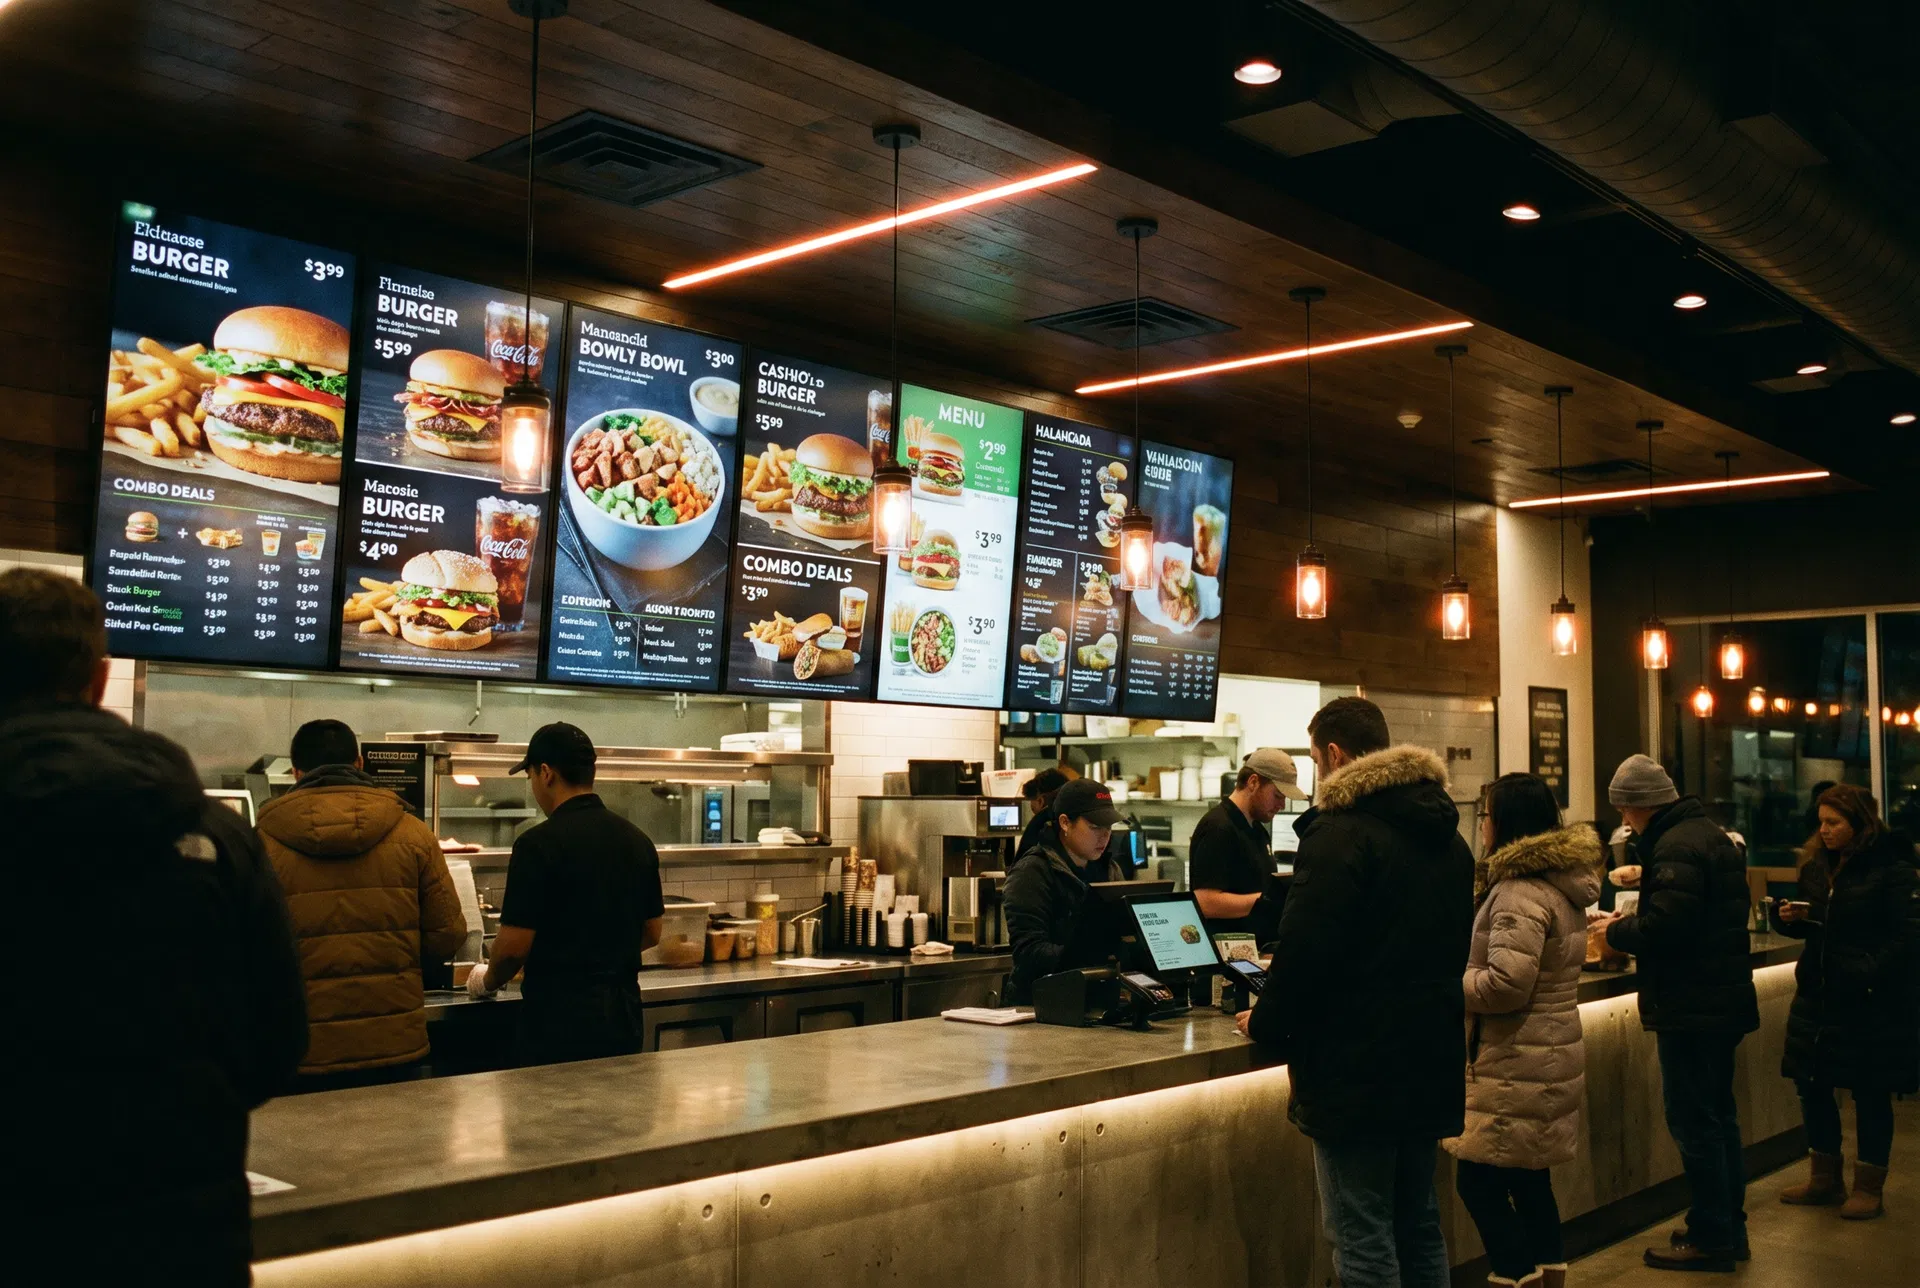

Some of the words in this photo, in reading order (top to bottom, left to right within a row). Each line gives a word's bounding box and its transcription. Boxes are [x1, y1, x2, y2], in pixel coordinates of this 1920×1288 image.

[132, 240, 230, 279] BURGER
[378, 294, 459, 328] BURGER
[580, 338, 637, 365] BOWLY
[640, 351, 688, 376] BOWL
[757, 378, 817, 405] BURGER
[938, 403, 985, 429] MENU
[113, 478, 169, 496] COMBO
[170, 485, 215, 501] DEALS
[362, 496, 445, 524] BURGER
[480, 534, 531, 560] Coca-Cola
[743, 555, 803, 577] COMBO
[805, 562, 853, 583] DEALS
[133, 586, 161, 598] Burger
